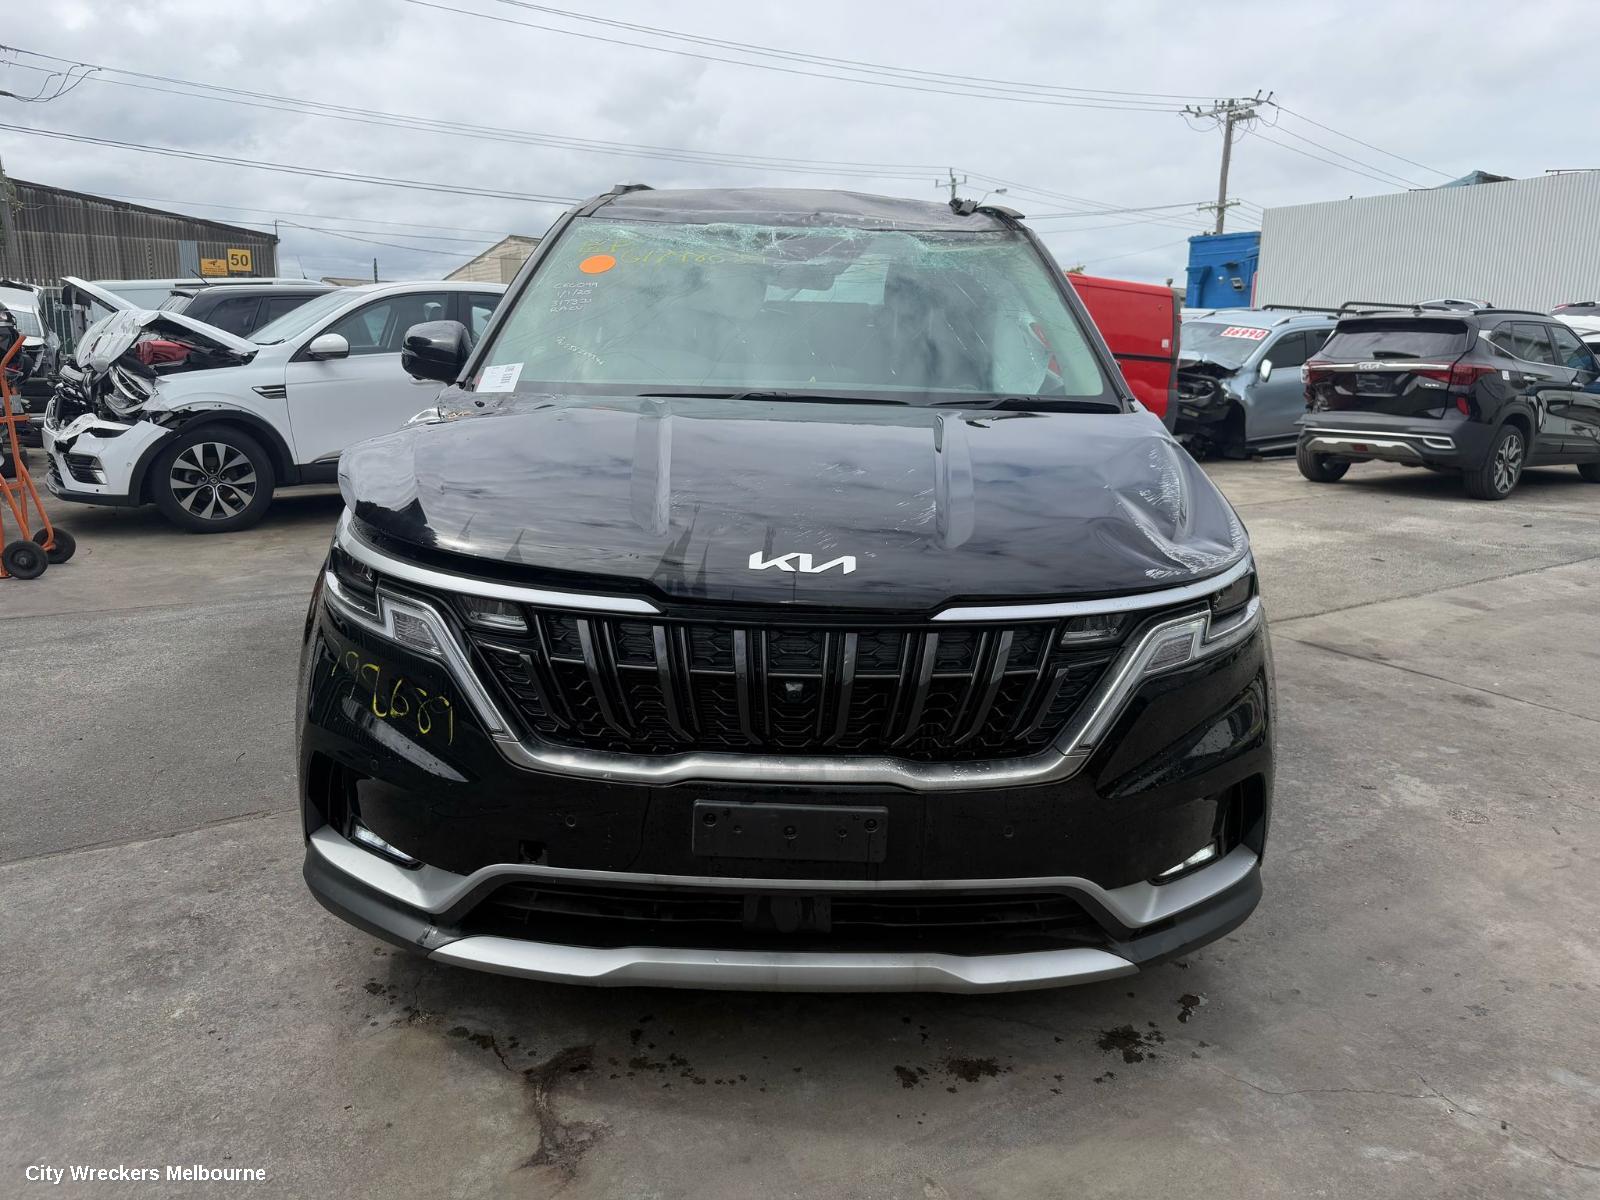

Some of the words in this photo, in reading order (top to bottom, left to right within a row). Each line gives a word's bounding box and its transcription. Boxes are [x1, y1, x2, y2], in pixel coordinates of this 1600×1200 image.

[231, 254, 248, 266] 50
[1223, 327, 1267, 339] 36990
[748, 550, 857, 575] KIA
